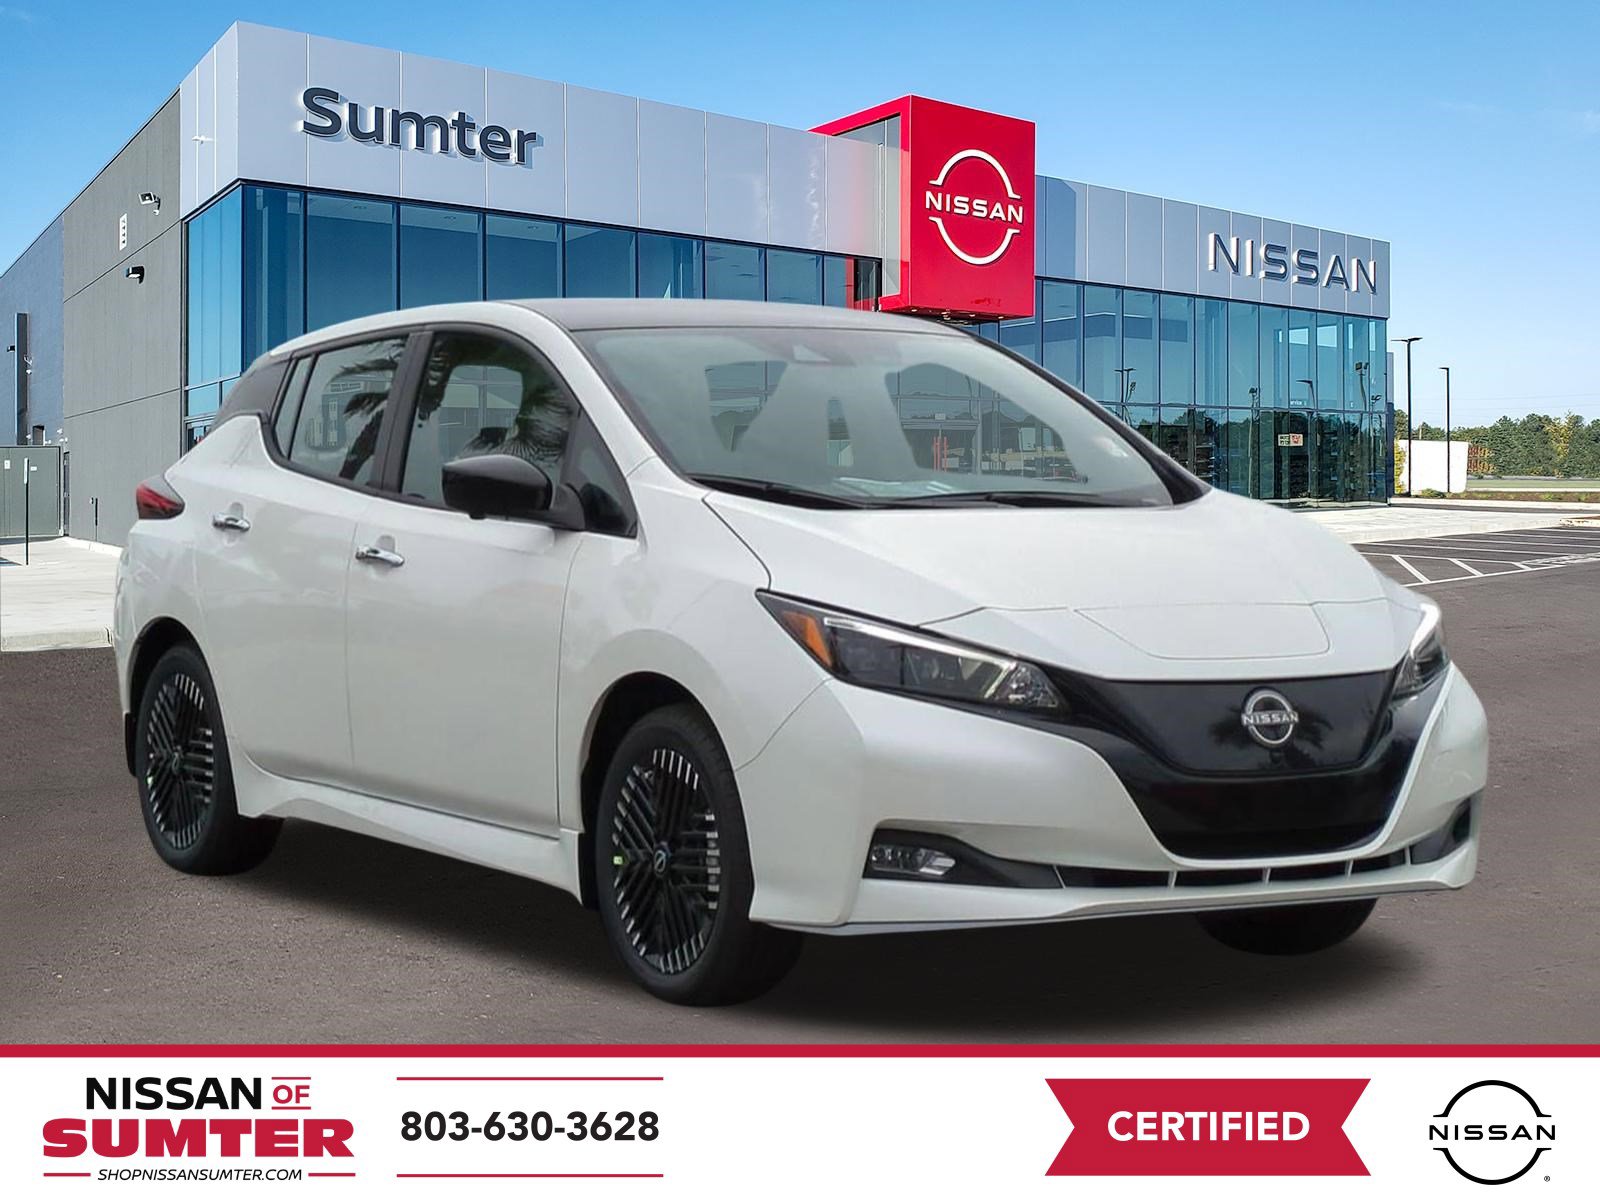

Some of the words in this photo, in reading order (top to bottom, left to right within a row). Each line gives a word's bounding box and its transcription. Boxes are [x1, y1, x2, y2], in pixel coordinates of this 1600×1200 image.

[302, 87, 537, 165] Sumter
[925, 190, 1023, 224] NISSAN
[1209, 232, 1377, 294] NISSAN
[1241, 711, 1299, 727] NISSAN
